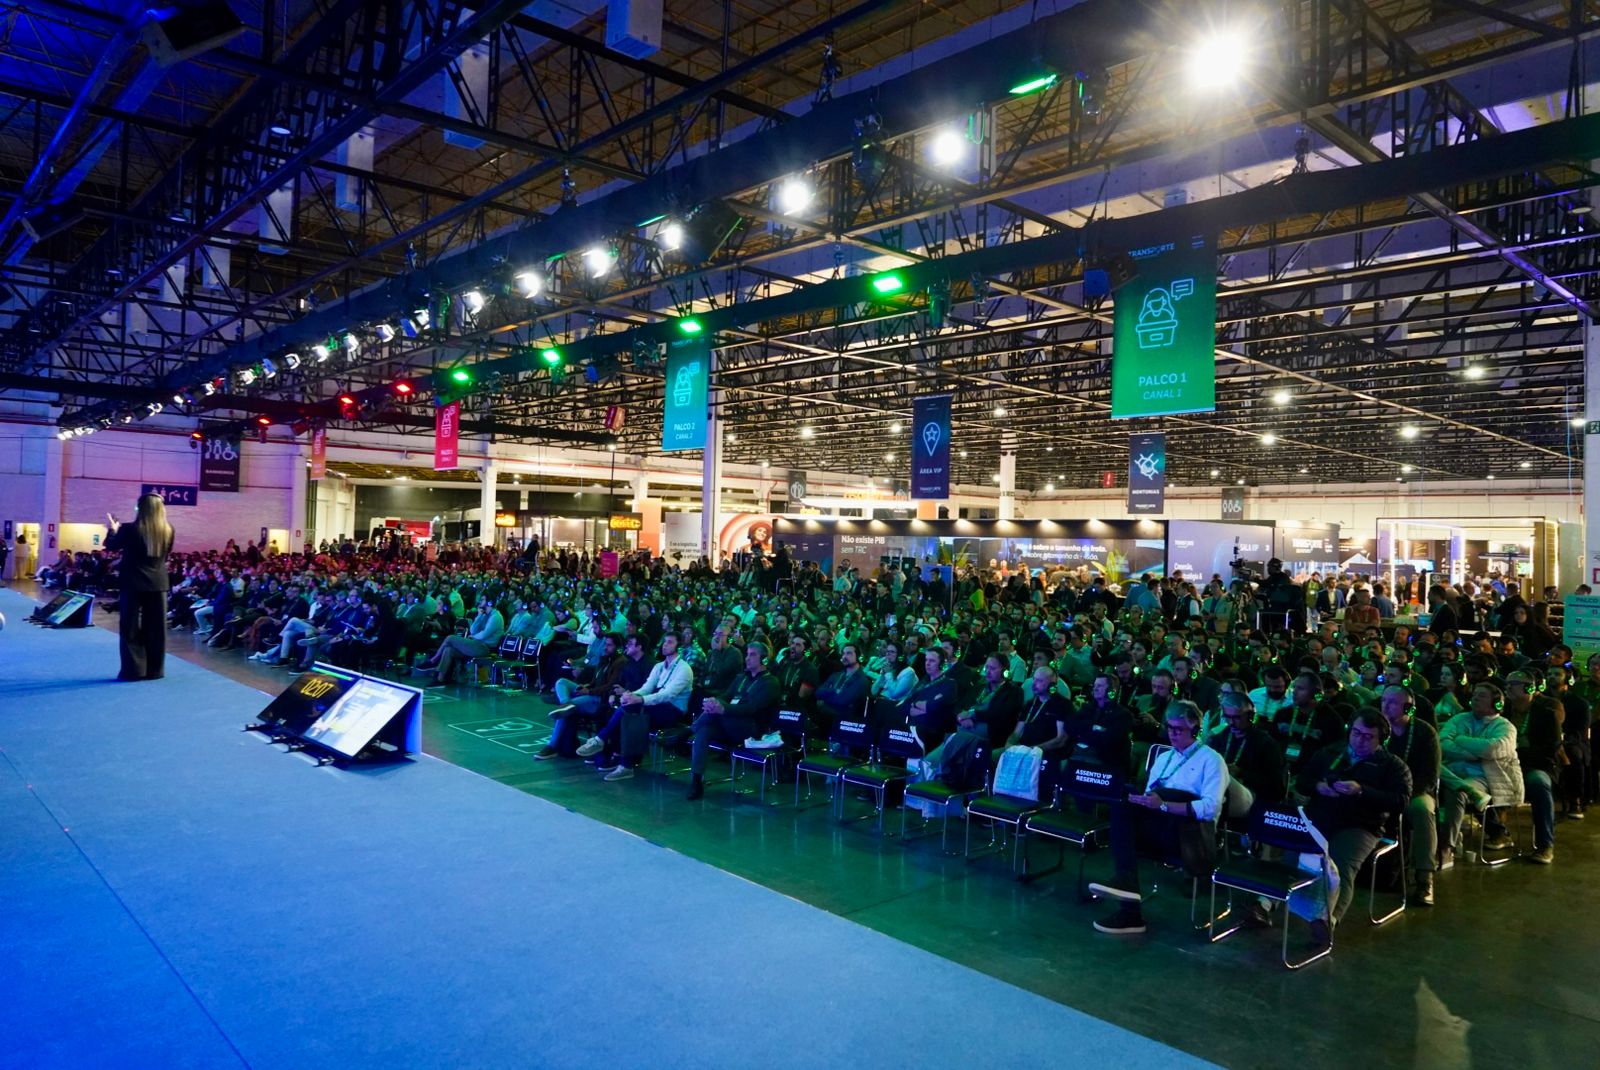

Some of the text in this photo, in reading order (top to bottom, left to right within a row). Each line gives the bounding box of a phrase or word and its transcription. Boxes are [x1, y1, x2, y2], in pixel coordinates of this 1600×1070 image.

[1138, 372, 1187, 387] PALCO 1
[1143, 388, 1182, 400] CANAL 1
[673, 422, 696, 431] PALCO 2
[841, 535, 885, 545] Não existe PIB
[1033, 543, 1049, 551] sobre
[1055, 544, 1081, 552] tamanho
[840, 720, 859, 728] ASSENTO
[840, 725, 864, 733] RESERVADO
[889, 729, 909, 737] ASSENTO
[889, 734, 914, 743] RESERVADO
[1075, 769, 1102, 779] ASSENTO
[1076, 775, 1110, 785] RESERVADO
[1264, 811, 1298, 823] ASSENTO
[1264, 817, 1309, 832] RESERVADO
